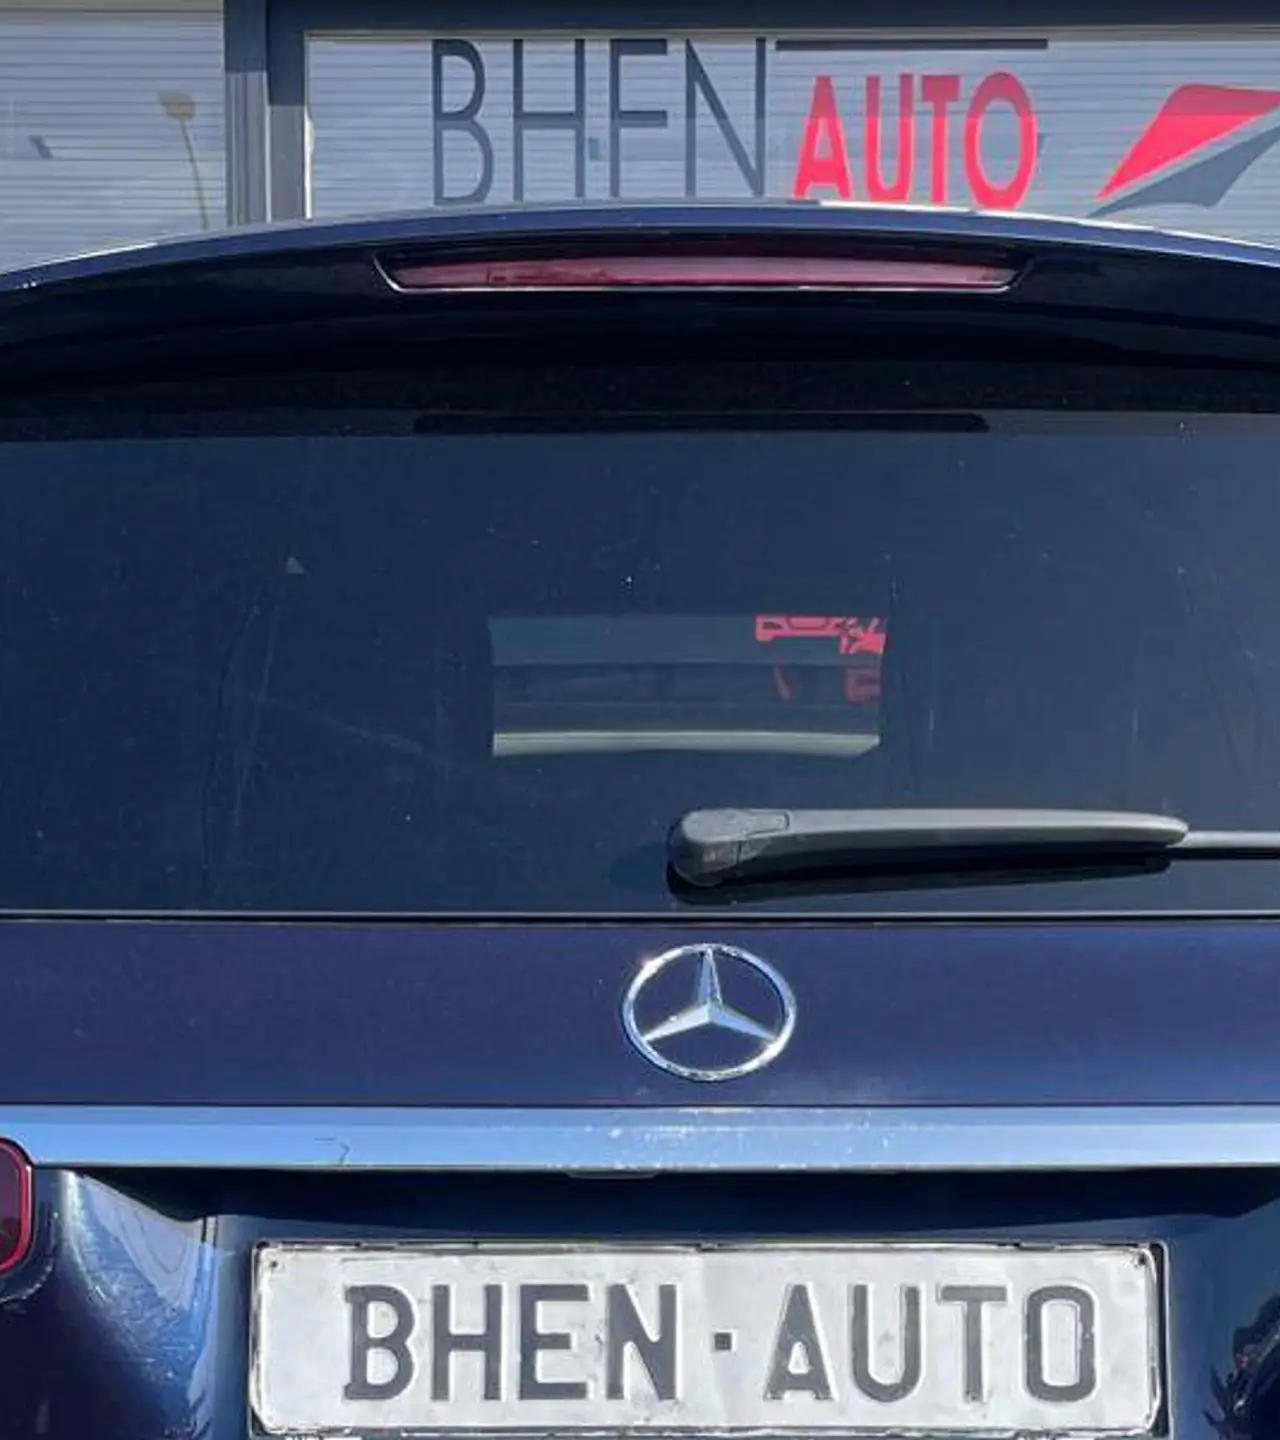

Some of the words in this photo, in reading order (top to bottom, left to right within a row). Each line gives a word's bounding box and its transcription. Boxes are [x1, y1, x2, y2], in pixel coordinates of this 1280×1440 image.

[431, 37, 766, 205] BHEN
[793, 72, 1037, 209] AUTO
[343, 1283, 679, 1402] BHEN
[763, 1283, 1098, 1403] AUTO
